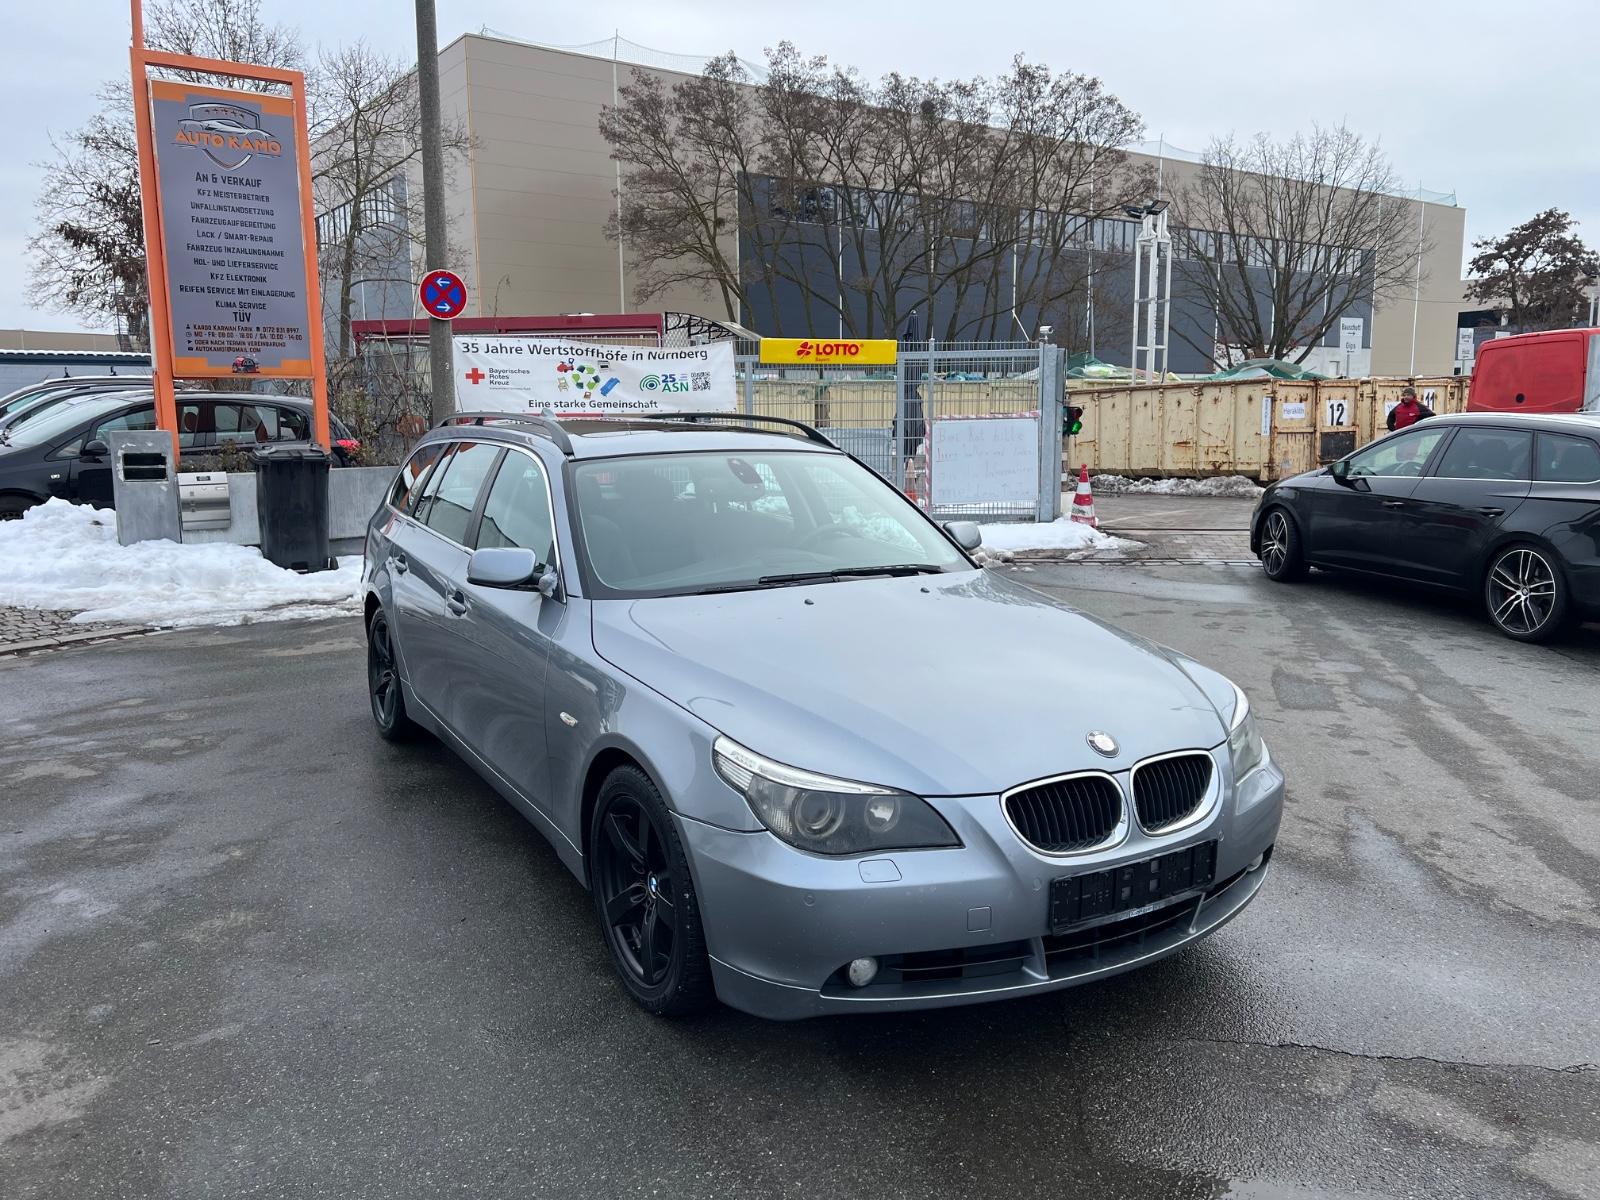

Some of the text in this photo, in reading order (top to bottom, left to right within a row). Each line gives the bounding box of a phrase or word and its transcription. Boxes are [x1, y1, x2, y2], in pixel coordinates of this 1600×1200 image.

[175, 128, 282, 154] AUTO KAMO
[212, 174, 217, 183] &
[221, 176, 262, 188] VERKAUF
[213, 190, 270, 202] MEISTERBETRIEB
[191, 202, 274, 216] UNFALLINSTANDSETZUNG
[191, 216, 276, 230] FAHRZEUGAUFBEREITUNG
[197, 230, 215, 238] LACK
[224, 232, 273, 243] SMART-REPAIR
[187, 243, 285, 257] FAHRZEUG INZAHLUNGNAHME
[228, 260, 278, 270] LIEFERSERVICE
[226, 274, 267, 283] ELEKTRONIK
[180, 285, 205, 293] REIFEN
[207, 286, 236, 295] SERVICE
[251, 288, 295, 298] EINLAGERUNG
[216, 300, 266, 310] KLIMA SERVICE
[233, 310, 251, 322] TÜV
[462, 342, 708, 360] 35 Jahre Wertstoffhöfe in Nürnberg
[815, 344, 859, 356] LOTTO
[661, 373, 677, 383] 25
[661, 381, 689, 392] ASN
[554, 400, 586, 408] starke
[589, 400, 658, 408] Gemeinschaft
[1425, 392, 1435, 411] 11
[1330, 403, 1344, 426] 12
